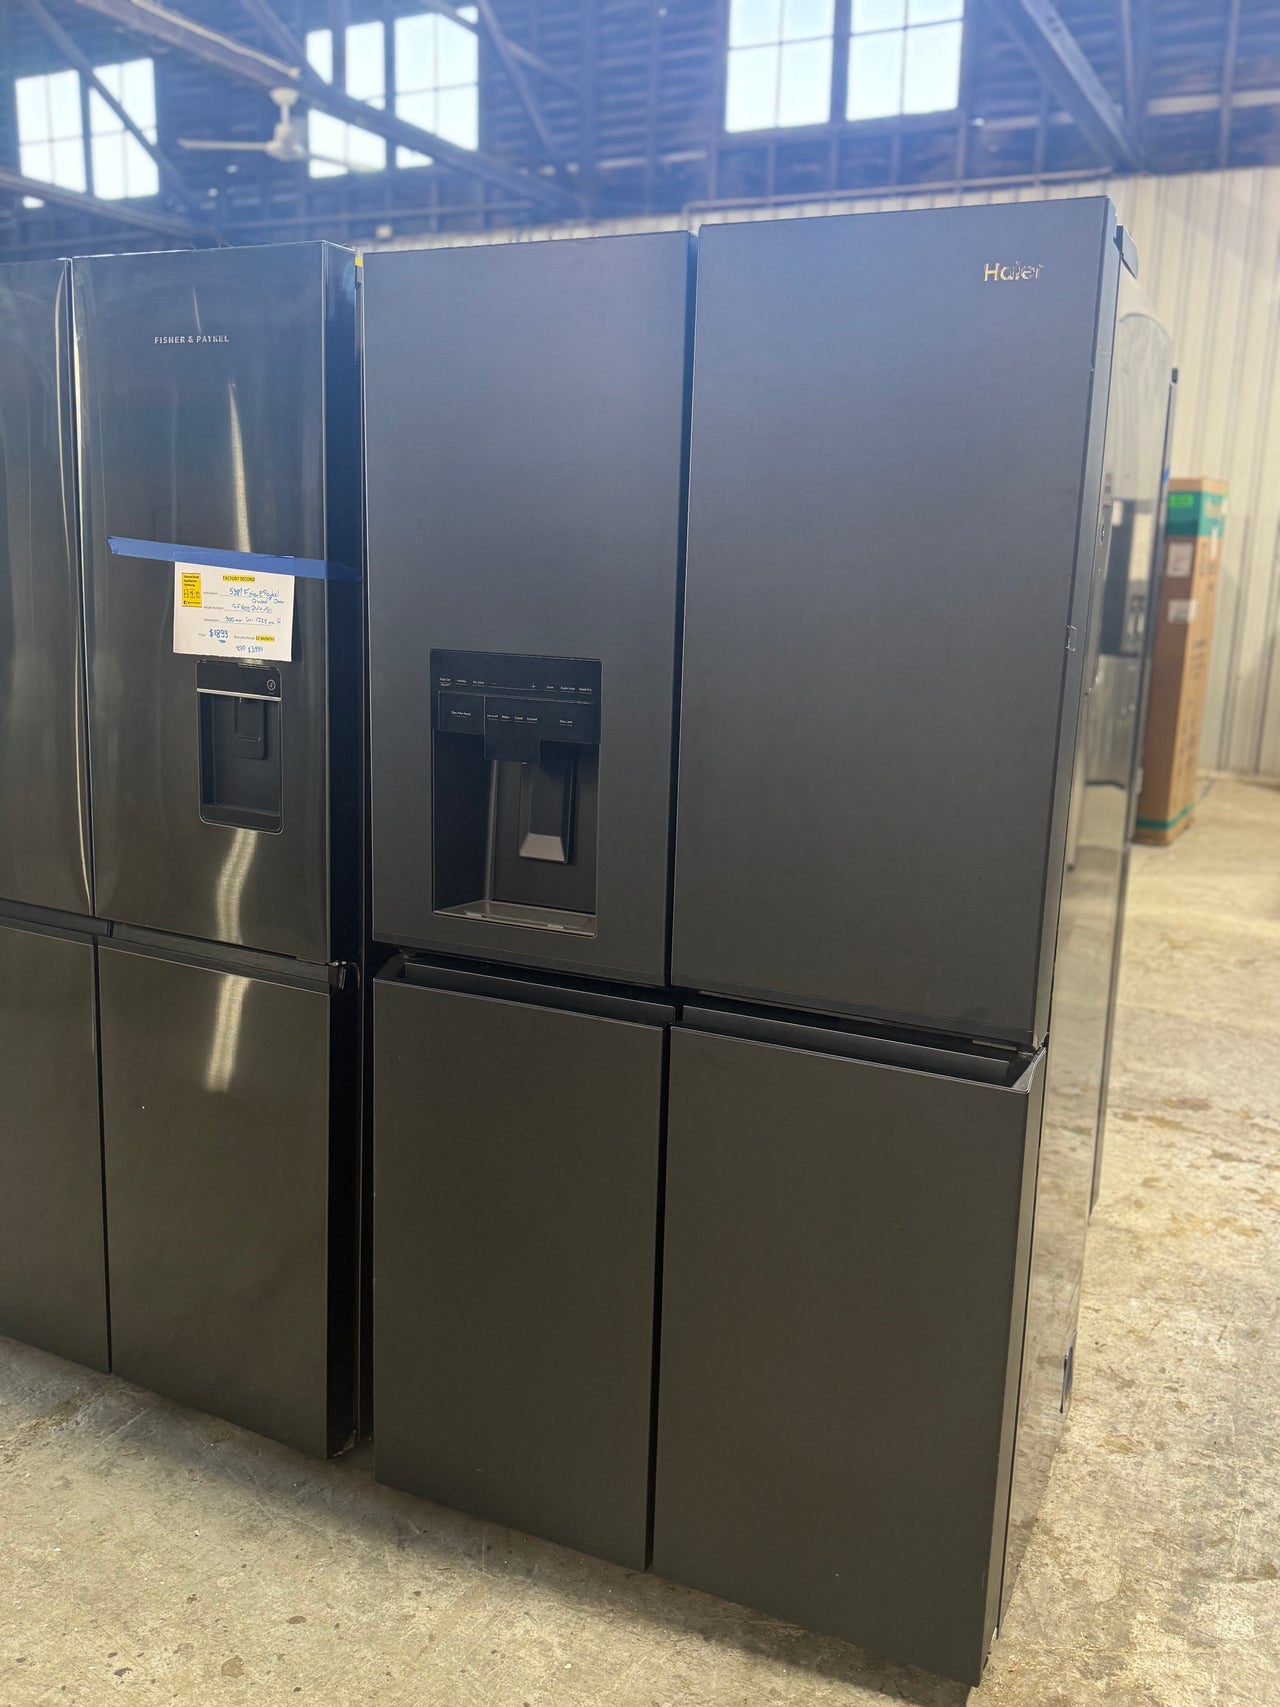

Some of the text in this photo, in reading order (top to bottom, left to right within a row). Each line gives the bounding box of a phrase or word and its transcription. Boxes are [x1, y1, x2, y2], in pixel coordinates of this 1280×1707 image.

[984, 260, 1044, 281] Haier
[154, 335, 229, 344] FISHER & PAYKEL
